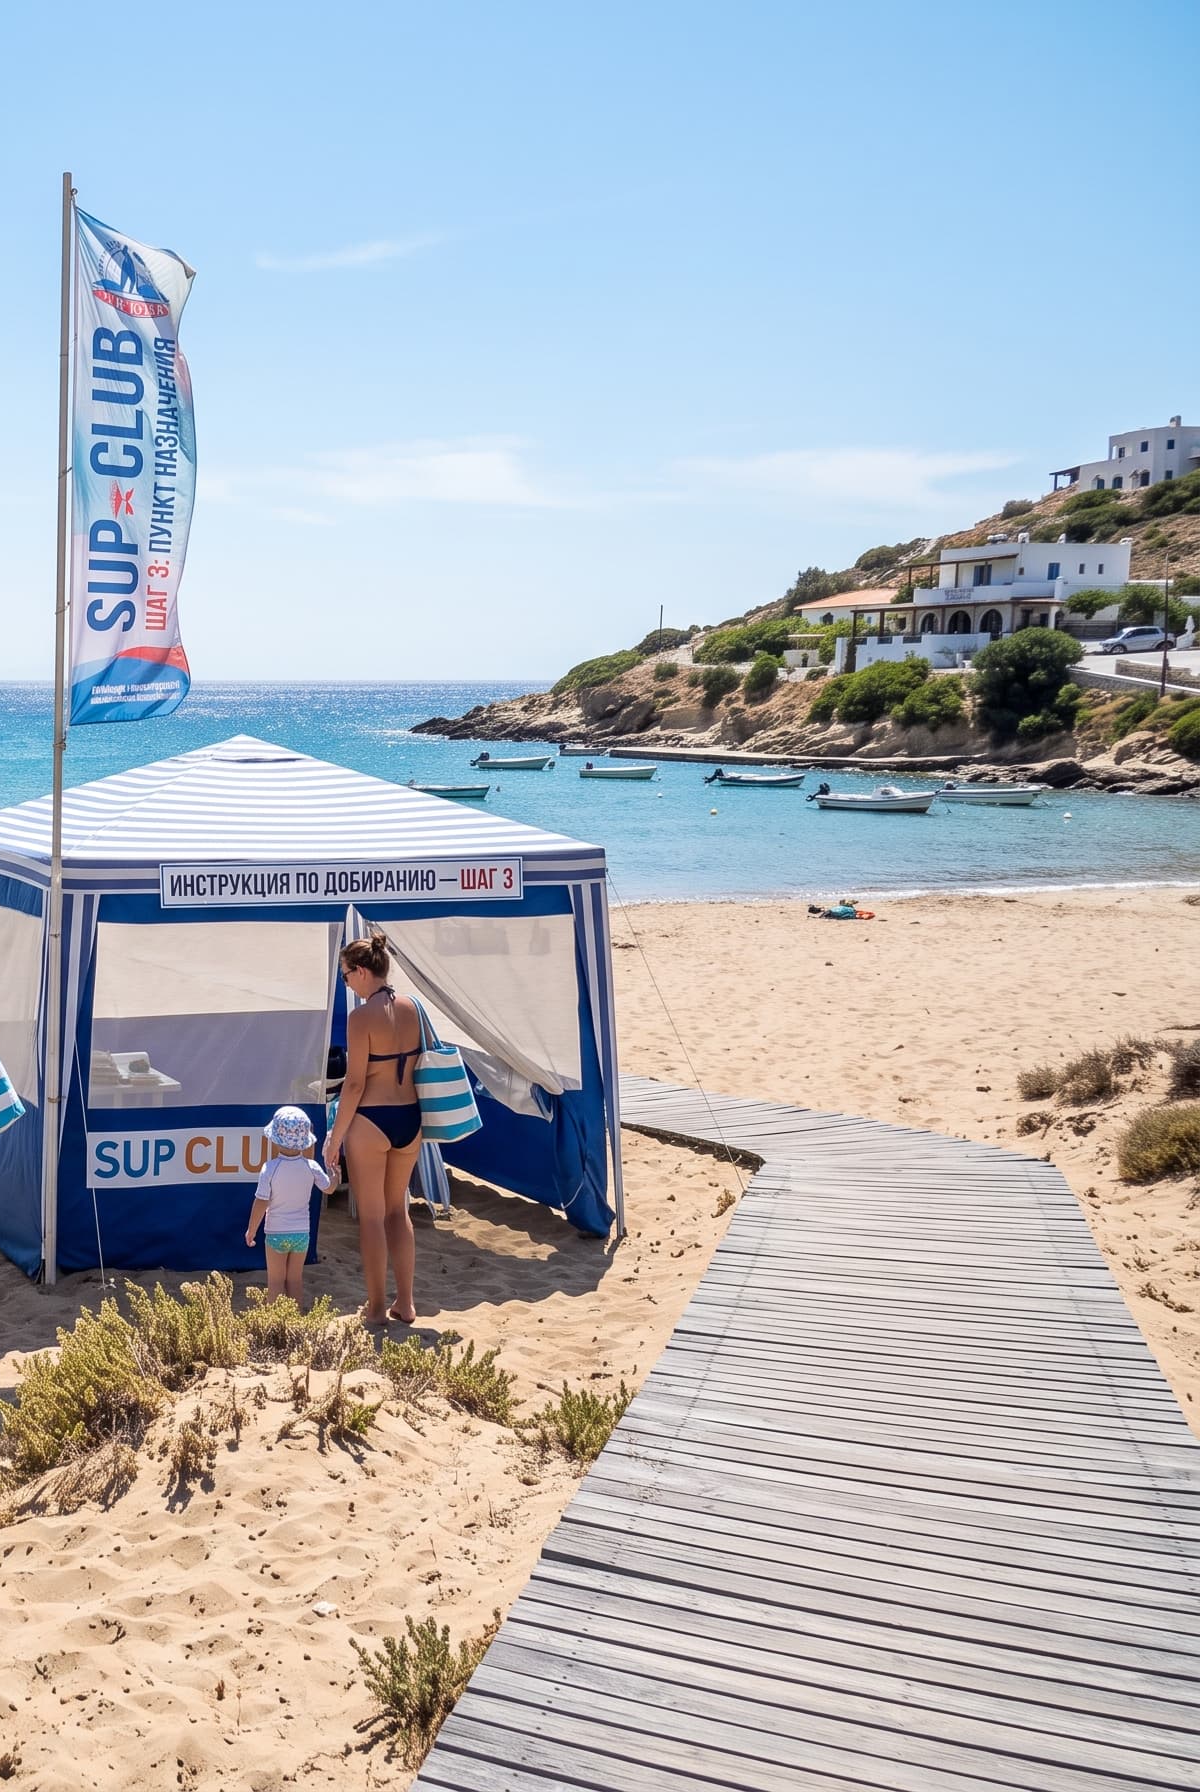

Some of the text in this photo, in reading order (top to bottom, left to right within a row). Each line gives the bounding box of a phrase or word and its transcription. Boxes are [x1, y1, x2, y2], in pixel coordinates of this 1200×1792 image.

[90, 327, 145, 478] CLUB
[145, 337, 179, 631] ШАГ 3: ПУНКТ НАЗНАЧЕНИЯ
[87, 519, 139, 632] SUP
[170, 871, 290, 898] ИНСТРУКЦИЯ
[295, 871, 318, 894] ПО
[324, 869, 436, 896] ДОБИРАНИЮ
[460, 868, 498, 890] ШАГ
[503, 867, 514, 889] 3
[94, 1135, 314, 1179] SUP CLU
